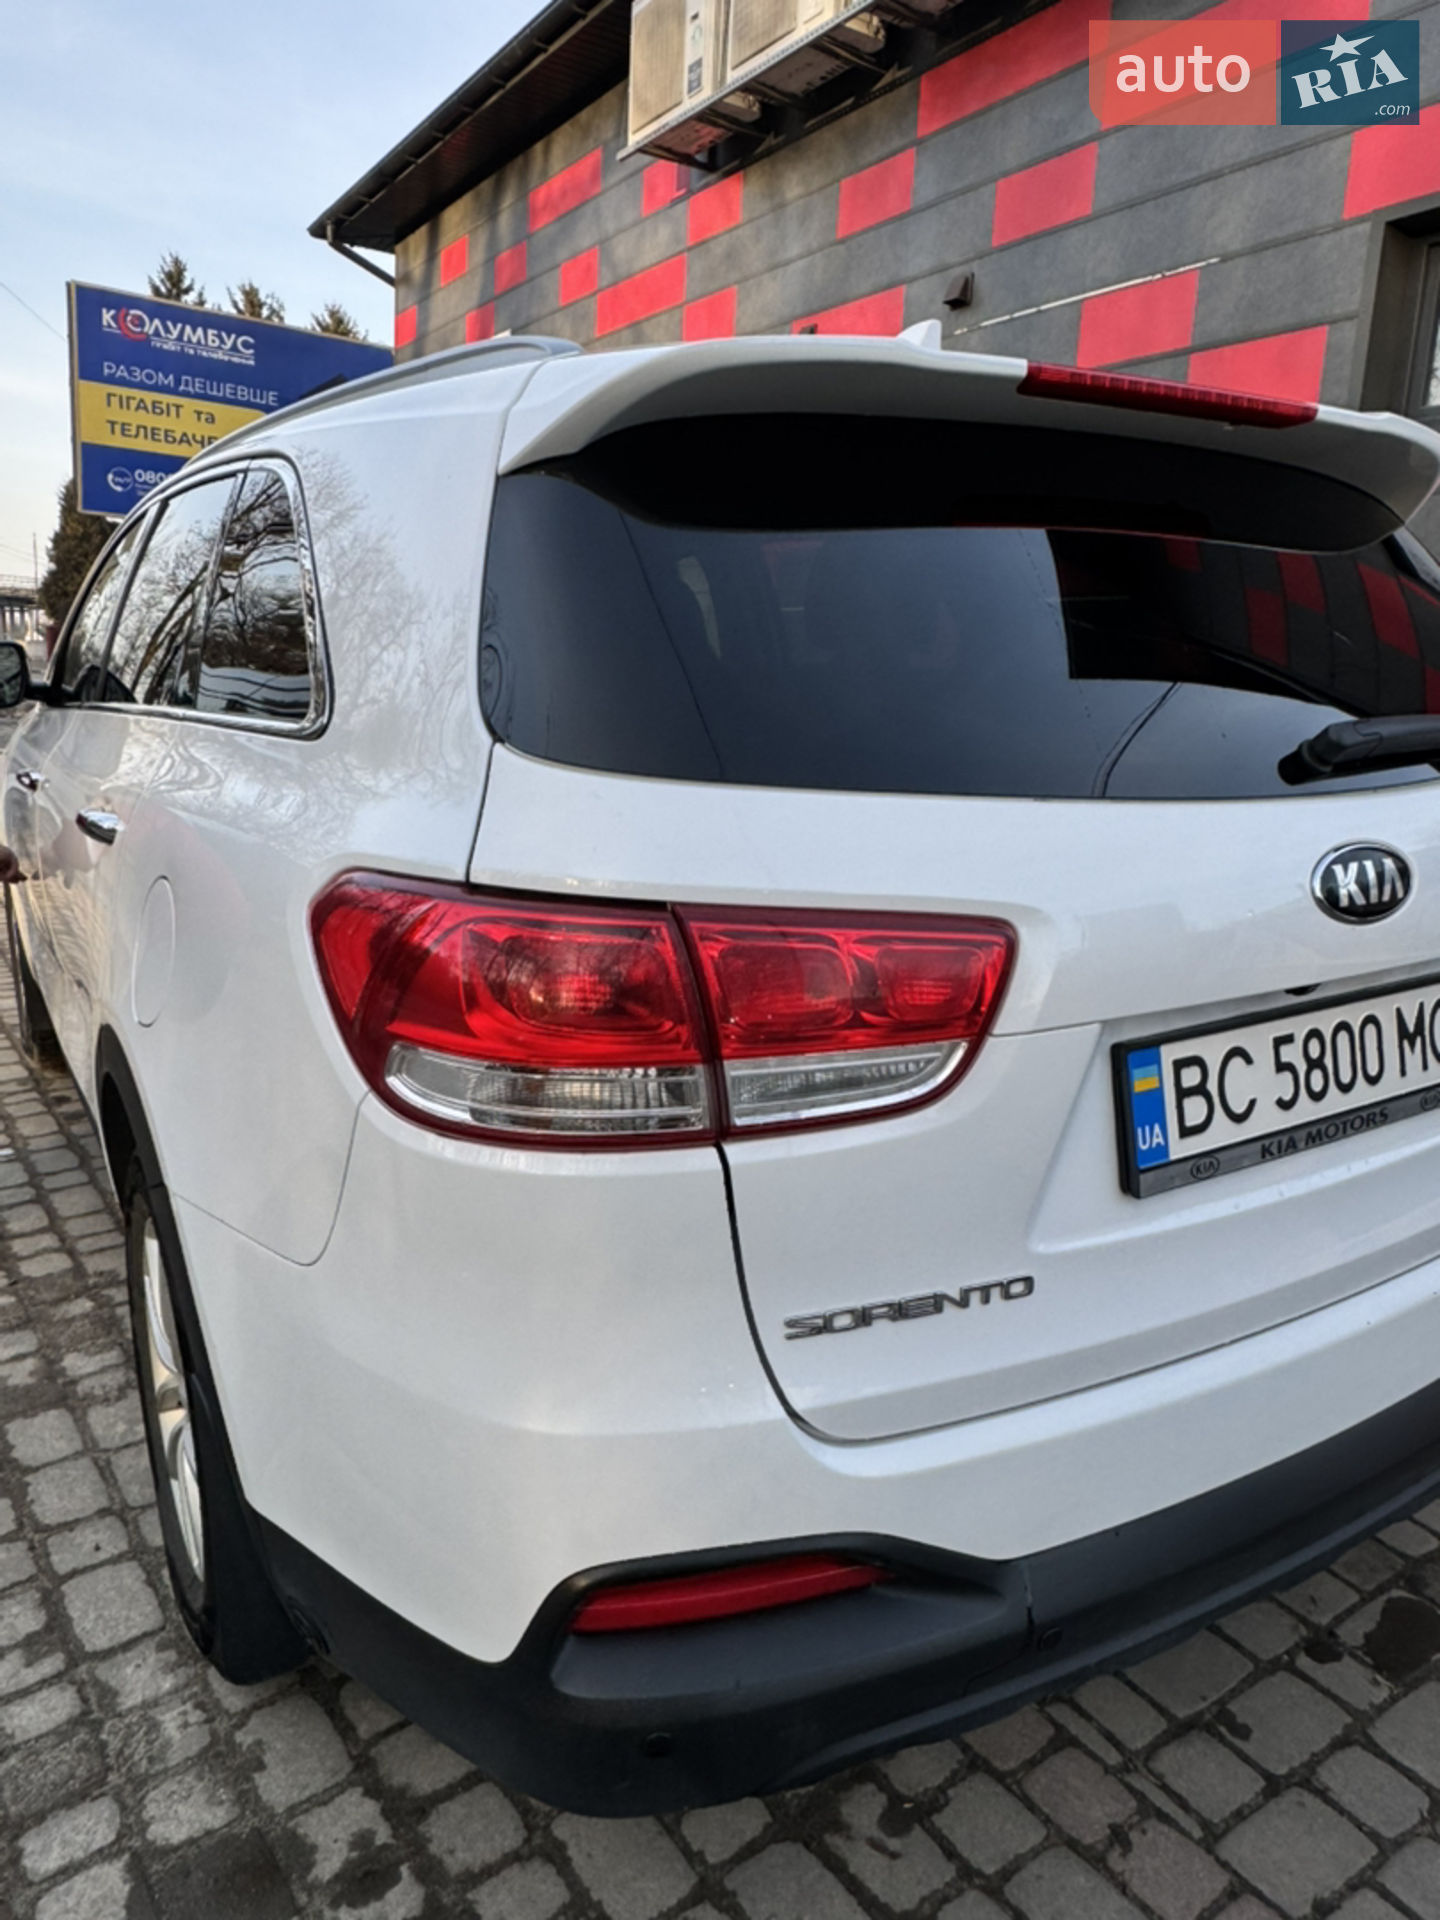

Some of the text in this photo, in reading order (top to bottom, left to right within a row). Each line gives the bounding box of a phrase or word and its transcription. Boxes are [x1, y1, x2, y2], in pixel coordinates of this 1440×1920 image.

[101, 306, 256, 354] КОЛУМБУС
[102, 361, 279, 406] РАЗОМ ДЕШЕВШЕ
[105, 391, 216, 425] ГІГАБІТ та
[134, 468, 174, 485] 080
[1330, 857, 1406, 908] KIA
[1171, 1046, 1258, 1140] BC
[1272, 1013, 1386, 1111] 5800
[1136, 1122, 1166, 1150] UA
[1260, 1107, 1390, 1160] KIA MOTORS
[1195, 1158, 1216, 1176] KIA
[783, 1274, 1035, 1340] SORENTO
